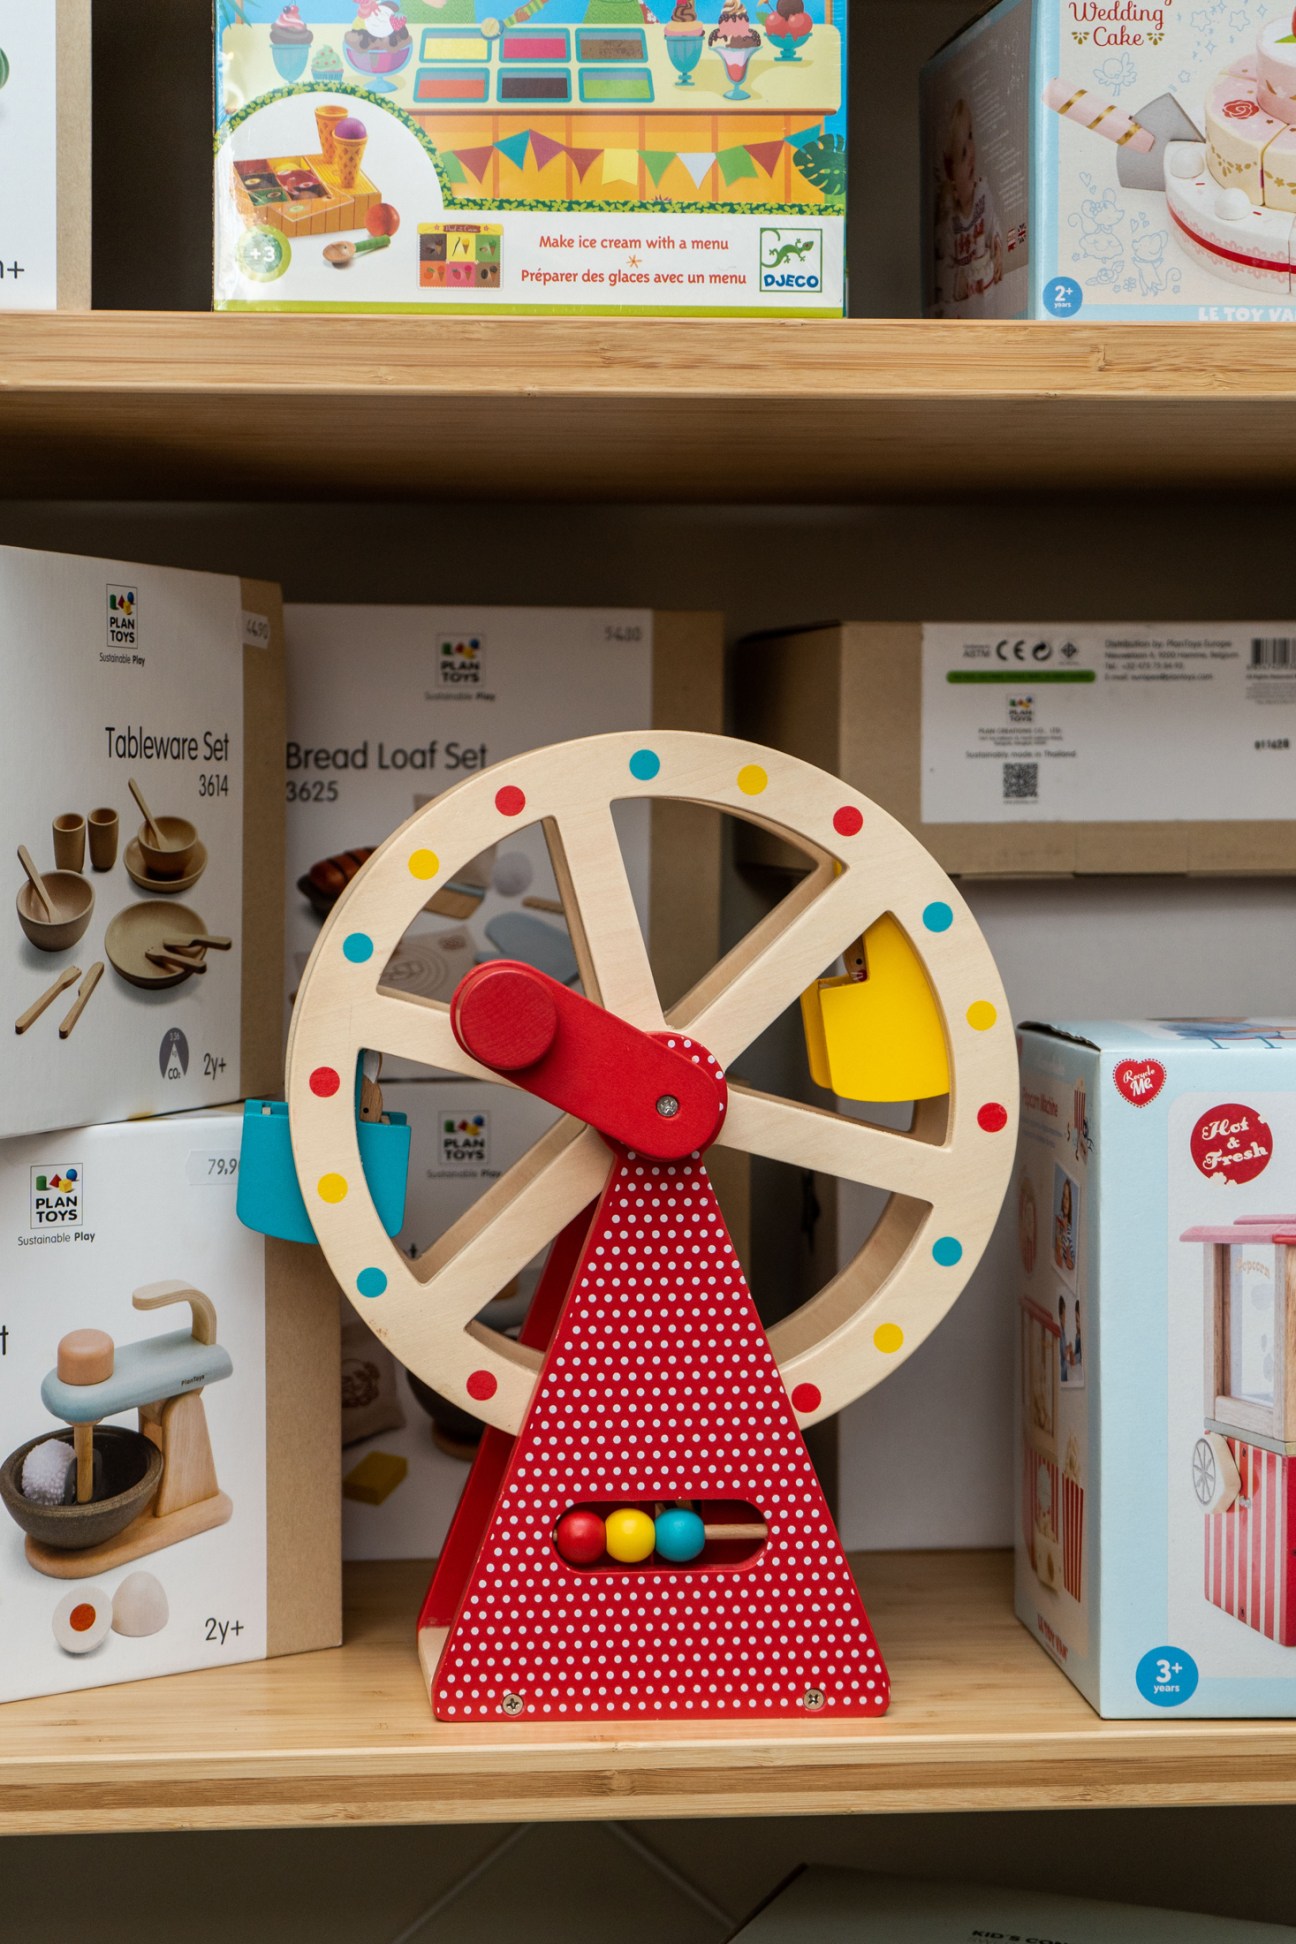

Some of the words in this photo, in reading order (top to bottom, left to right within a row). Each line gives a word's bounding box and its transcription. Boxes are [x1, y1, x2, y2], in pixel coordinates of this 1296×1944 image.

[1069, 1, 1164, 30] Wedding
[1093, 25, 1144, 46] Cake
[539, 235, 574, 248] Make
[578, 235, 597, 249] ice
[600, 238, 642, 249] cream
[646, 236, 675, 250] with
[678, 239, 687, 250] a
[691, 239, 729, 250] menu
[249, 245, 276, 263] +3
[521, 268, 578, 285] Préparer
[582, 269, 605, 283] des
[609, 270, 650, 286] glaces
[653, 273, 684, 284] avec
[688, 274, 705, 284] un
[709, 274, 747, 284] menu
[763, 274, 819, 288] DJECO
[1054, 285, 1073, 301] 2+
[1198, 307, 1220, 321] LE
[1223, 307, 1265, 321] TOY
[1268, 308, 1296, 321] VA
[109, 616, 135, 630] PLAN
[110, 630, 135, 643] TOYS
[99, 652, 131, 665] Sustainable
[132, 656, 145, 667] Play
[441, 661, 480, 671] PLAN
[442, 672, 480, 683] TOYS
[105, 725, 198, 760] Tableware
[203, 731, 229, 761] Set
[286, 741, 368, 770] Bread
[378, 740, 438, 770] Loaf
[445, 742, 489, 770] Set
[199, 774, 229, 797] 3614
[286, 780, 339, 803] 3625
[203, 1053, 226, 1081] 2y+
[1123, 1066, 1155, 1083] Recycle
[1202, 1117, 1249, 1141] Hot
[443, 1138, 485, 1148] PLAN
[1226, 1137, 1240, 1149] &
[445, 1149, 485, 1160] TOYS
[1202, 1141, 1268, 1170] Fresh
[207, 1158, 240, 1175] 79,9
[36, 1196, 78, 1209] PLAN
[36, 1209, 78, 1223] TOYS
[18, 1232, 71, 1246] Sustainable
[74, 1232, 95, 1244] Play
[205, 1617, 244, 1645] 2y+
[1155, 1659, 1183, 1683] 3+
[1153, 1685, 1180, 1694] years
